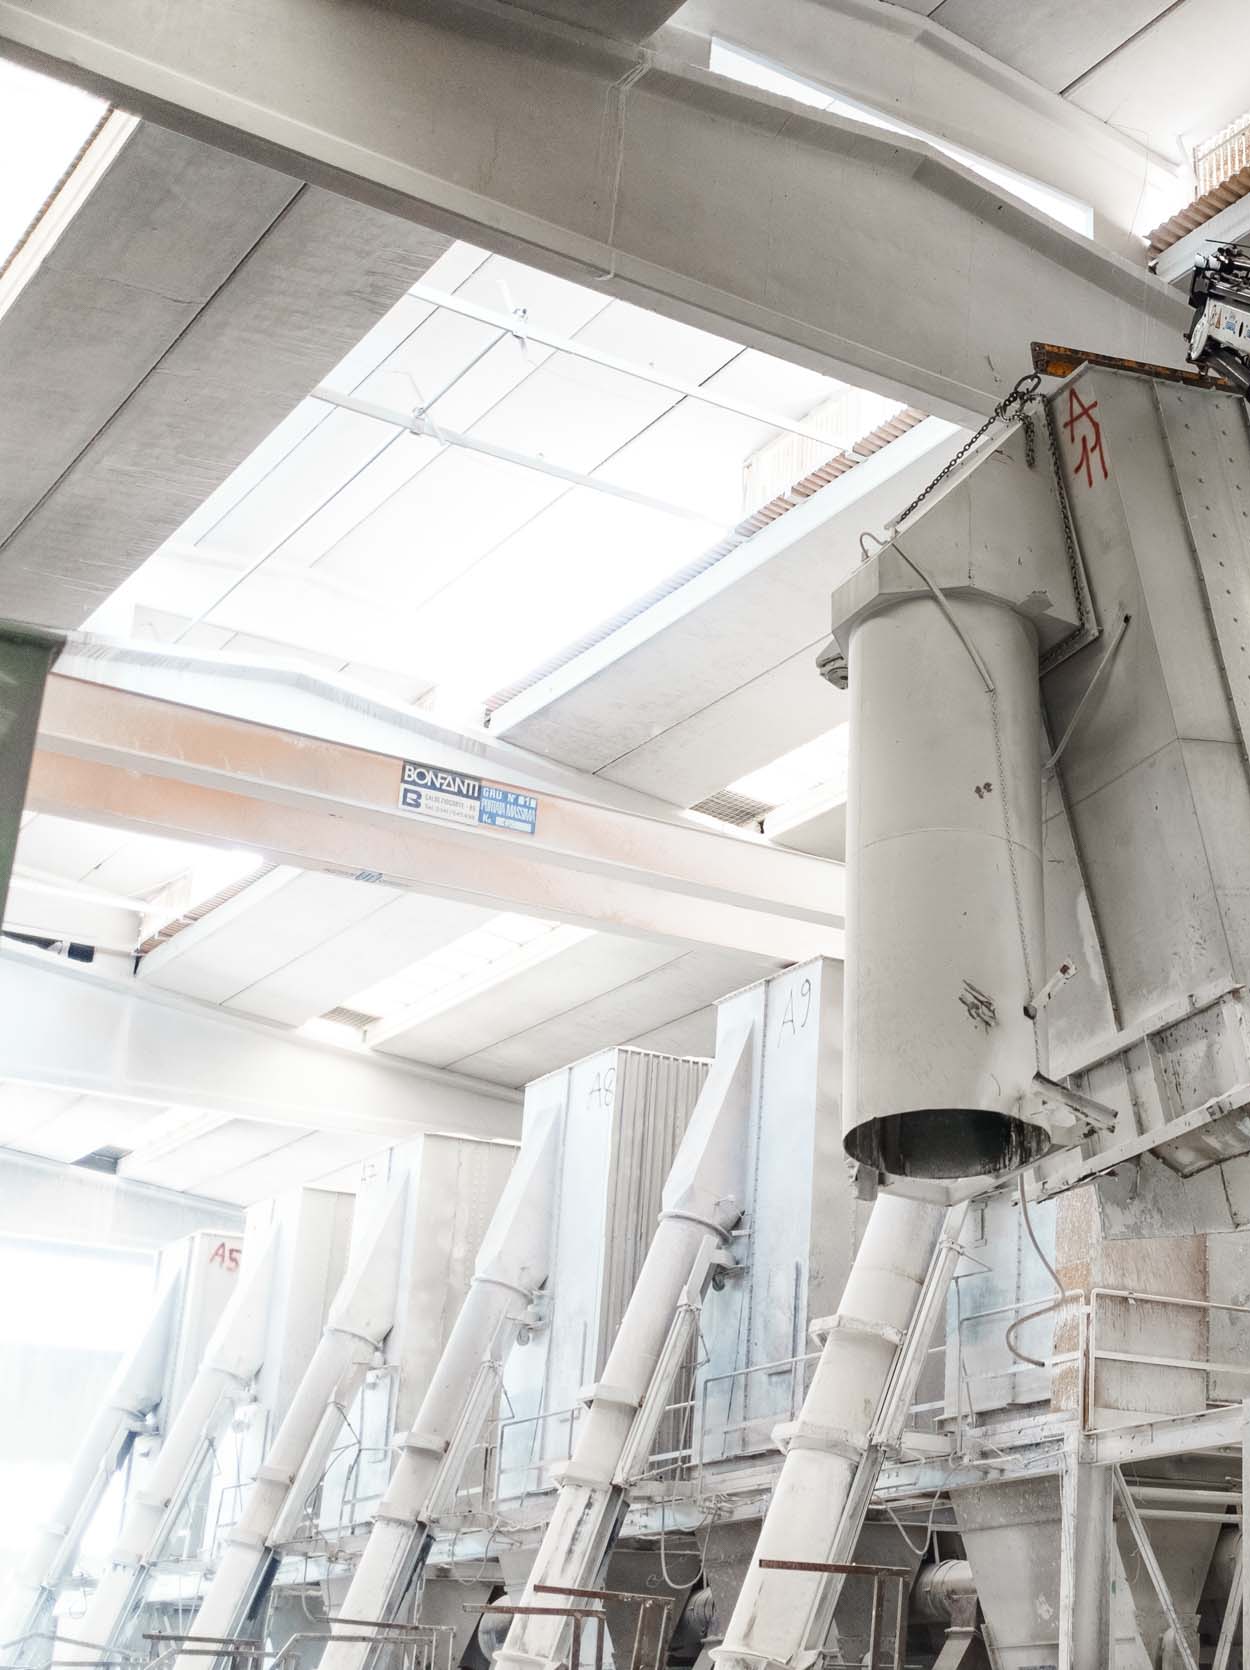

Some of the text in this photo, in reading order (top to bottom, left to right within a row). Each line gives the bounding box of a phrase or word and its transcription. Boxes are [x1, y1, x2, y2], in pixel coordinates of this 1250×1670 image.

[404, 765, 479, 798] BONFANTI
[482, 787, 503, 800] GRU
[777, 978, 811, 1048] A9
[209, 1241, 242, 1272] A5
